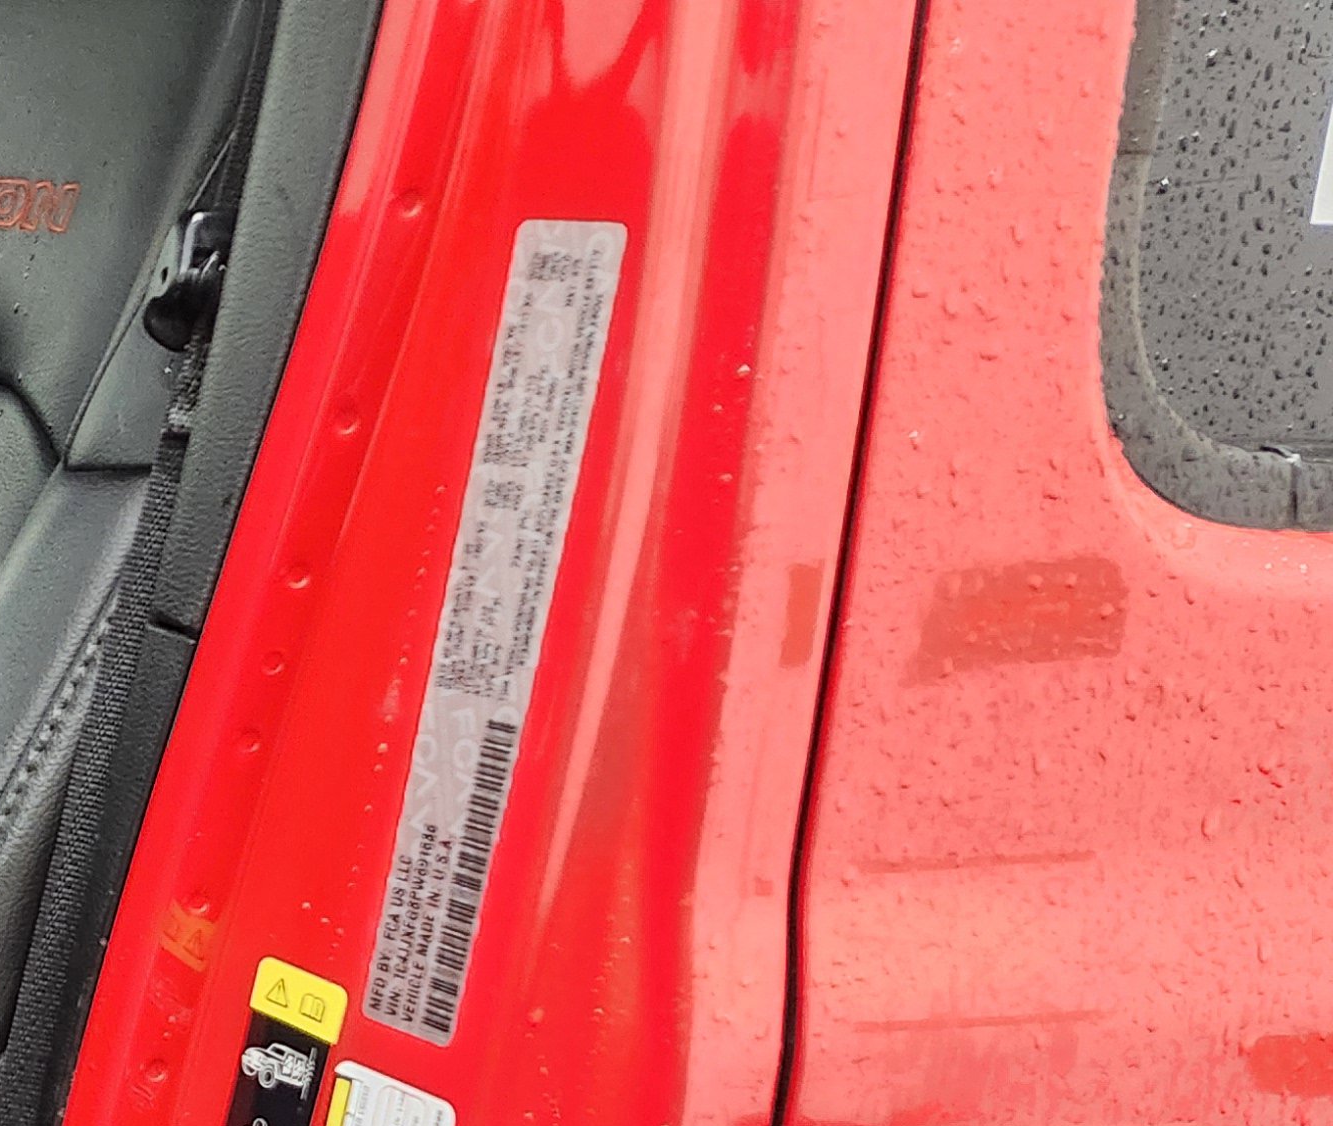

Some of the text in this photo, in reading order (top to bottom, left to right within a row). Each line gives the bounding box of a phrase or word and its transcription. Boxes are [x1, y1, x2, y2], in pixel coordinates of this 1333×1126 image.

[396, 855, 412, 882] LLC
[391, 886, 405, 907] US
[383, 914, 400, 941] FCA
[401, 963, 425, 1022] VEHICLE
[415, 915, 437, 957] MADE
[369, 976, 388, 1012] MFD
[385, 984, 403, 1017] VIN:
